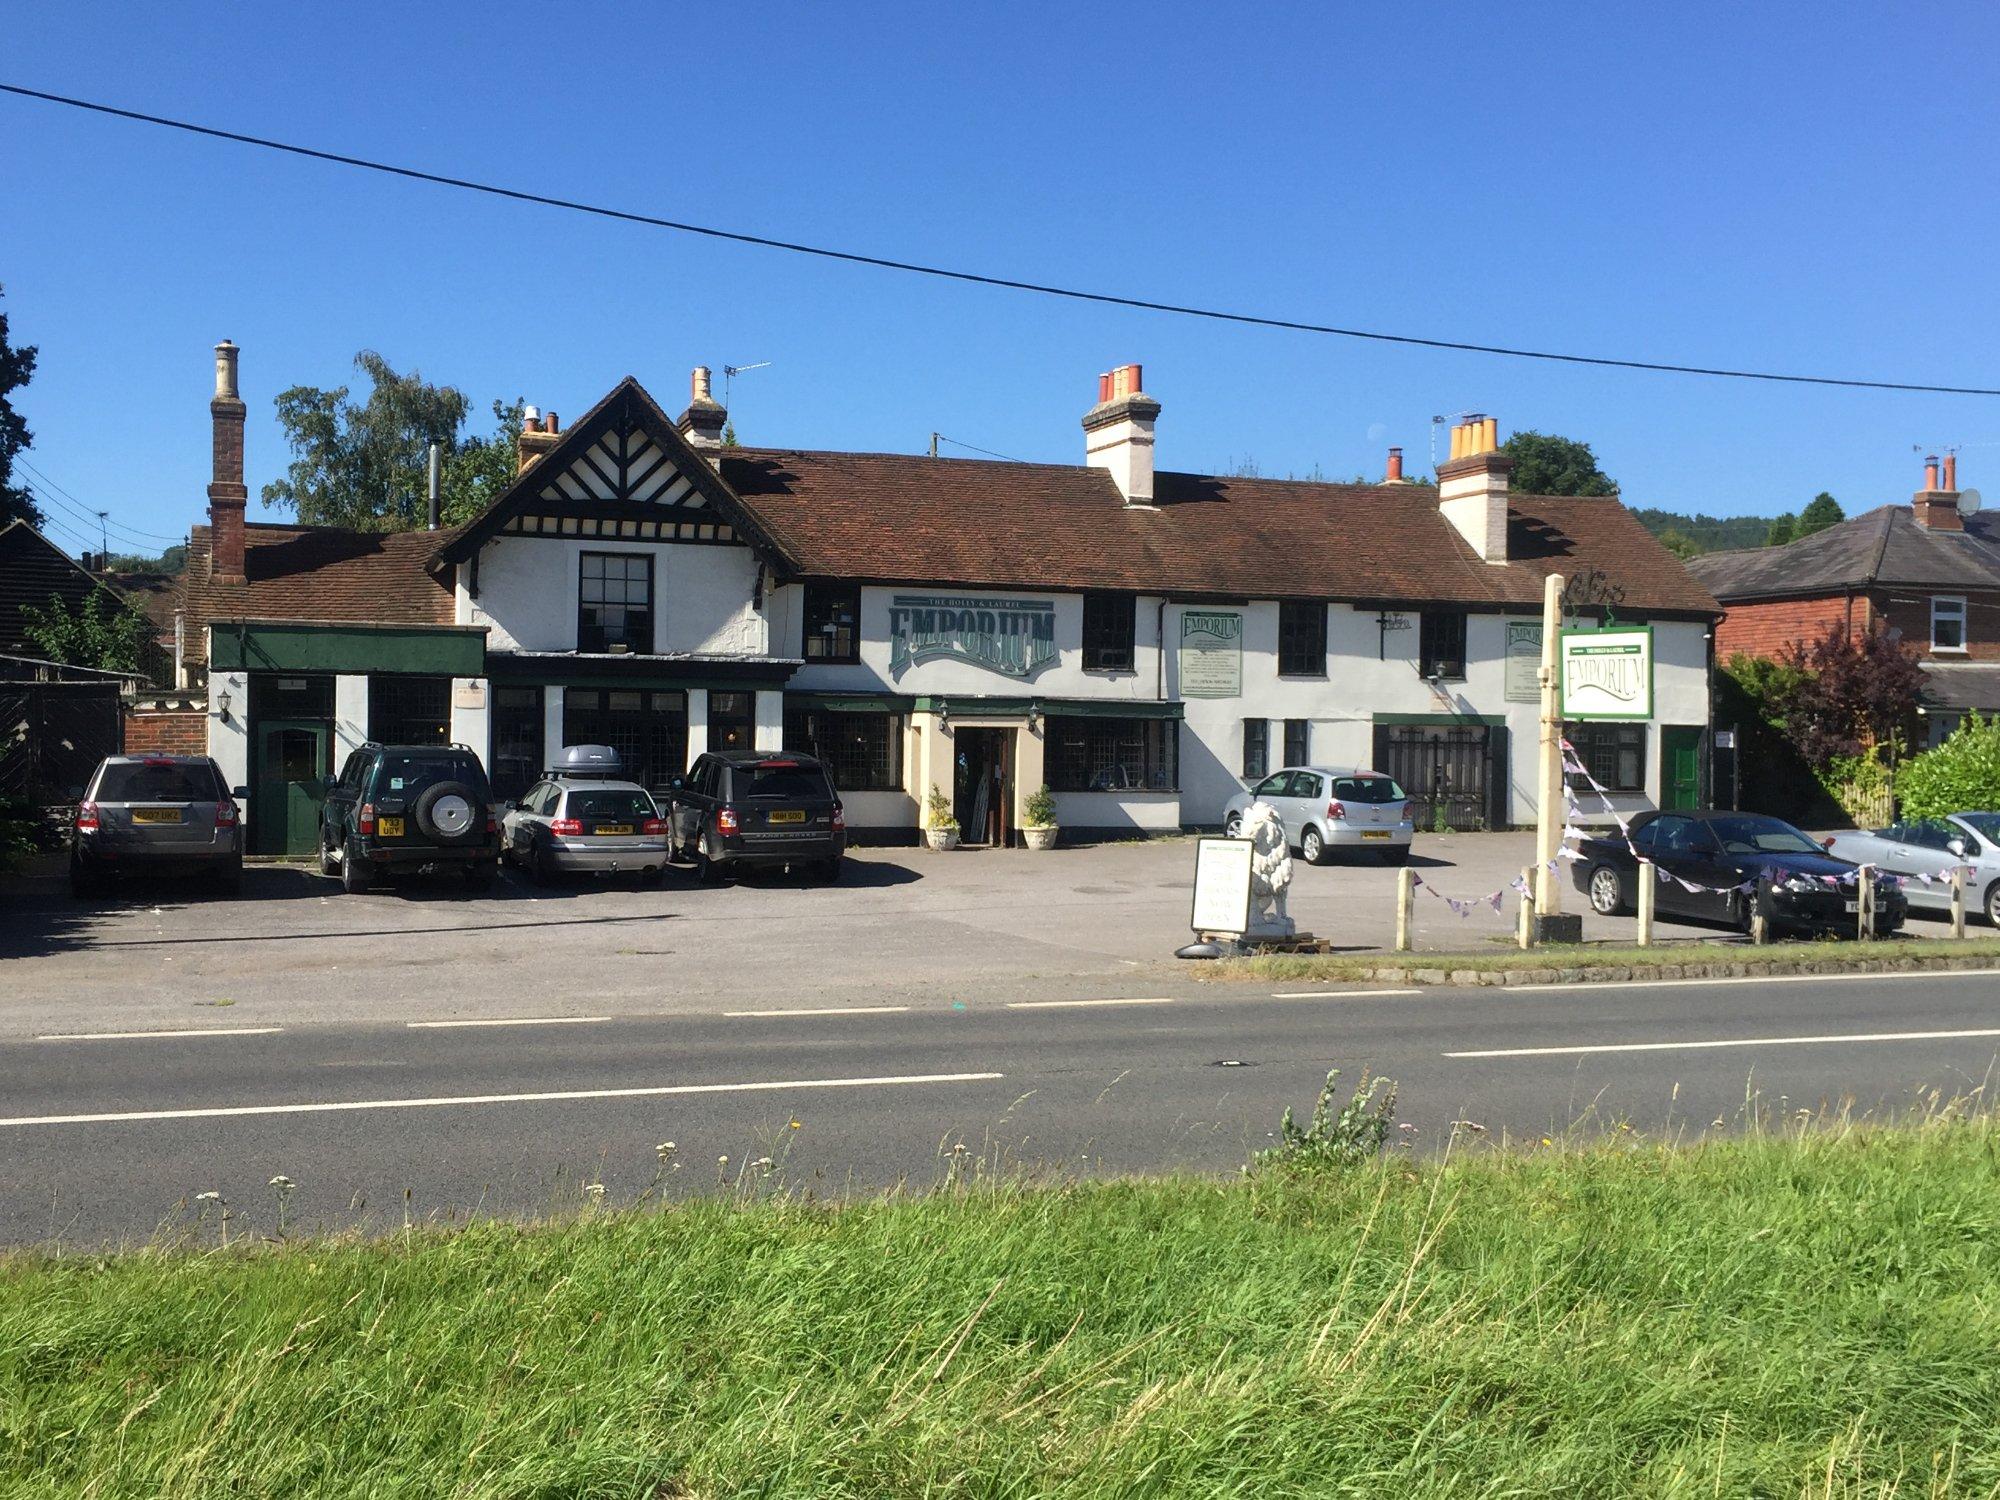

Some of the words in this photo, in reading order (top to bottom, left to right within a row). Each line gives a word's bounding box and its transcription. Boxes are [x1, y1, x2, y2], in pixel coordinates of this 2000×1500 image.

[928, 598, 946, 606] THE
[948, 599, 976, 607] HOLLY
[1184, 617, 1240, 637] EMPORIUM
[1508, 627, 1543, 647] EMPOR
[889, 607, 1056, 674] EMPORIUM
[1567, 658, 1645, 698] EMPORIUM
